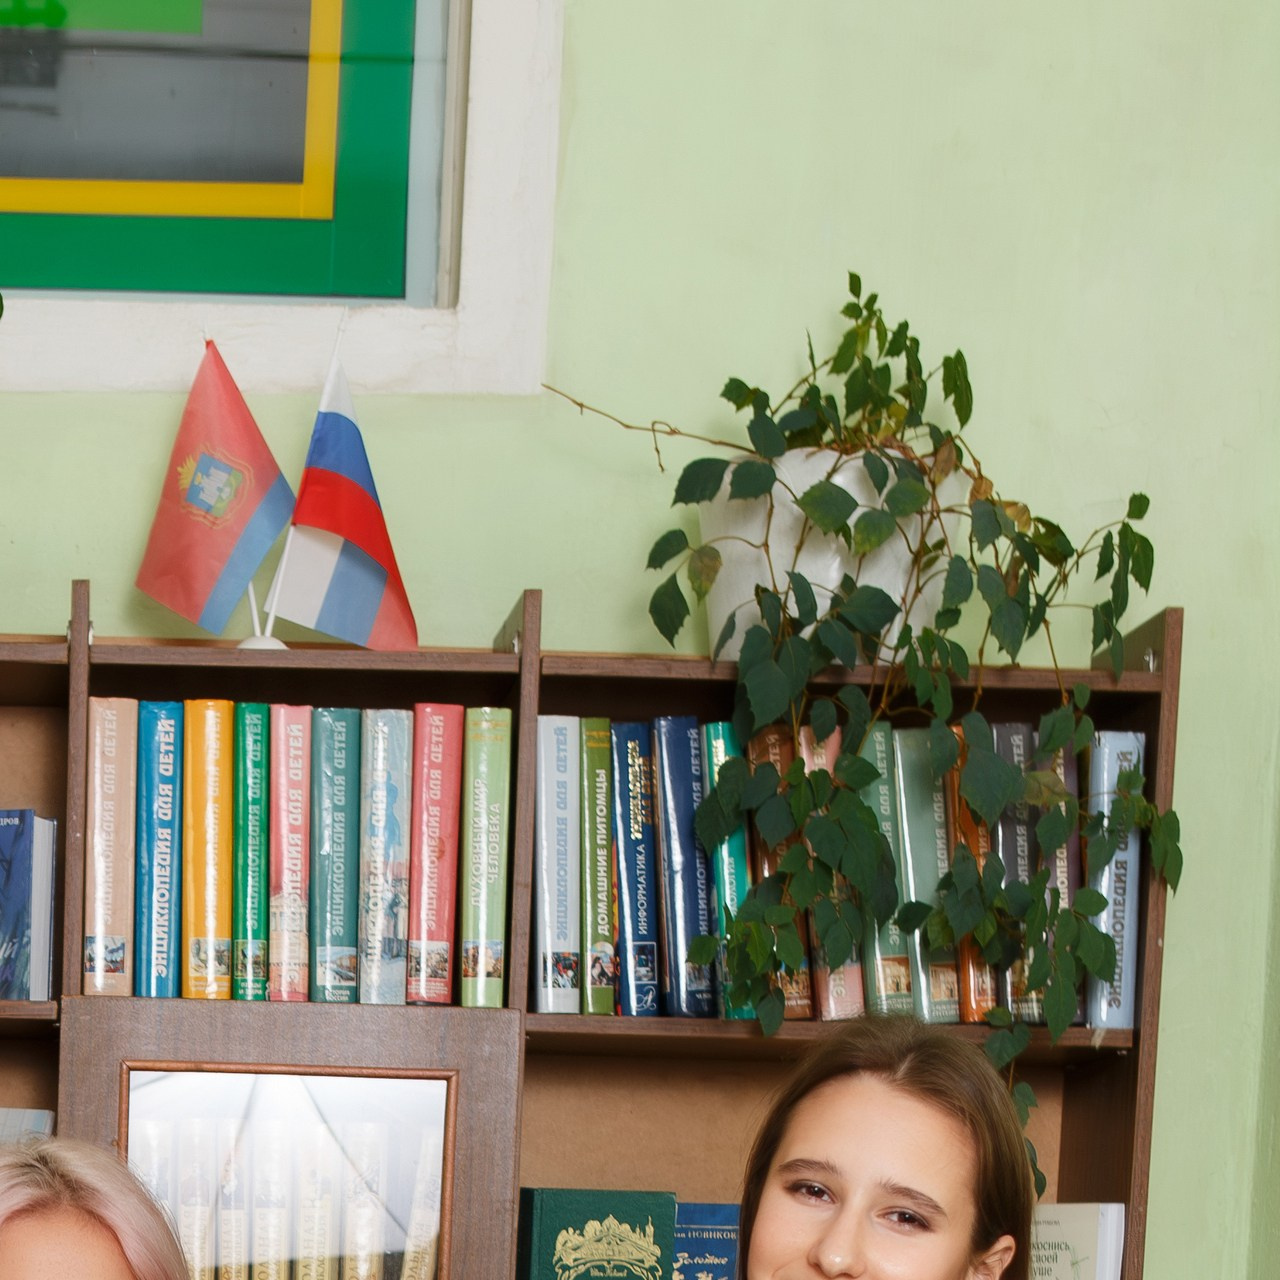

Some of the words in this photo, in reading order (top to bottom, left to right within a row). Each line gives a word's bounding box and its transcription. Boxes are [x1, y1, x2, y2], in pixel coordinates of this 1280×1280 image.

[158, 718, 175, 777] ДЕТЕЙ
[286, 724, 304, 781] ДЕТЕЙ
[331, 721, 346, 770] ДЕТЕЙ
[427, 715, 443, 764] ДЕТЕЙ
[554, 727, 568, 774] ДЕТЕЙ
[687, 728, 701, 776] ДЕТЕЙ
[158, 784, 174, 821] ДЛЯ
[286, 789, 303, 827] ДЛЯ
[332, 775, 346, 806] ДЛЯ
[429, 769, 442, 801] ДЛЯ
[555, 780, 568, 811] ДЛЯ
[594, 769, 609, 846] ПИТОМЦЫ
[878, 785, 889, 816] ДЛЯ
[487, 802, 501, 884] ЧЕЛОВЕКА
[332, 812, 346, 937] ЭНЦИКЛОПЕДИЯ
[425, 806, 441, 931] ЭНЦИКЛОПЕДИЯ
[596, 847, 610, 936] ДОМАШНИЕ
[636, 844, 650, 935] ИНФОРМАТИКА
[154, 828, 172, 978] ЭНЦИКЛОПЕДИЯ
[284, 834, 303, 983] ЭНЦИКЛОПЕДИЯ
[688, 1231, 737, 1241] НОВИКОВ
